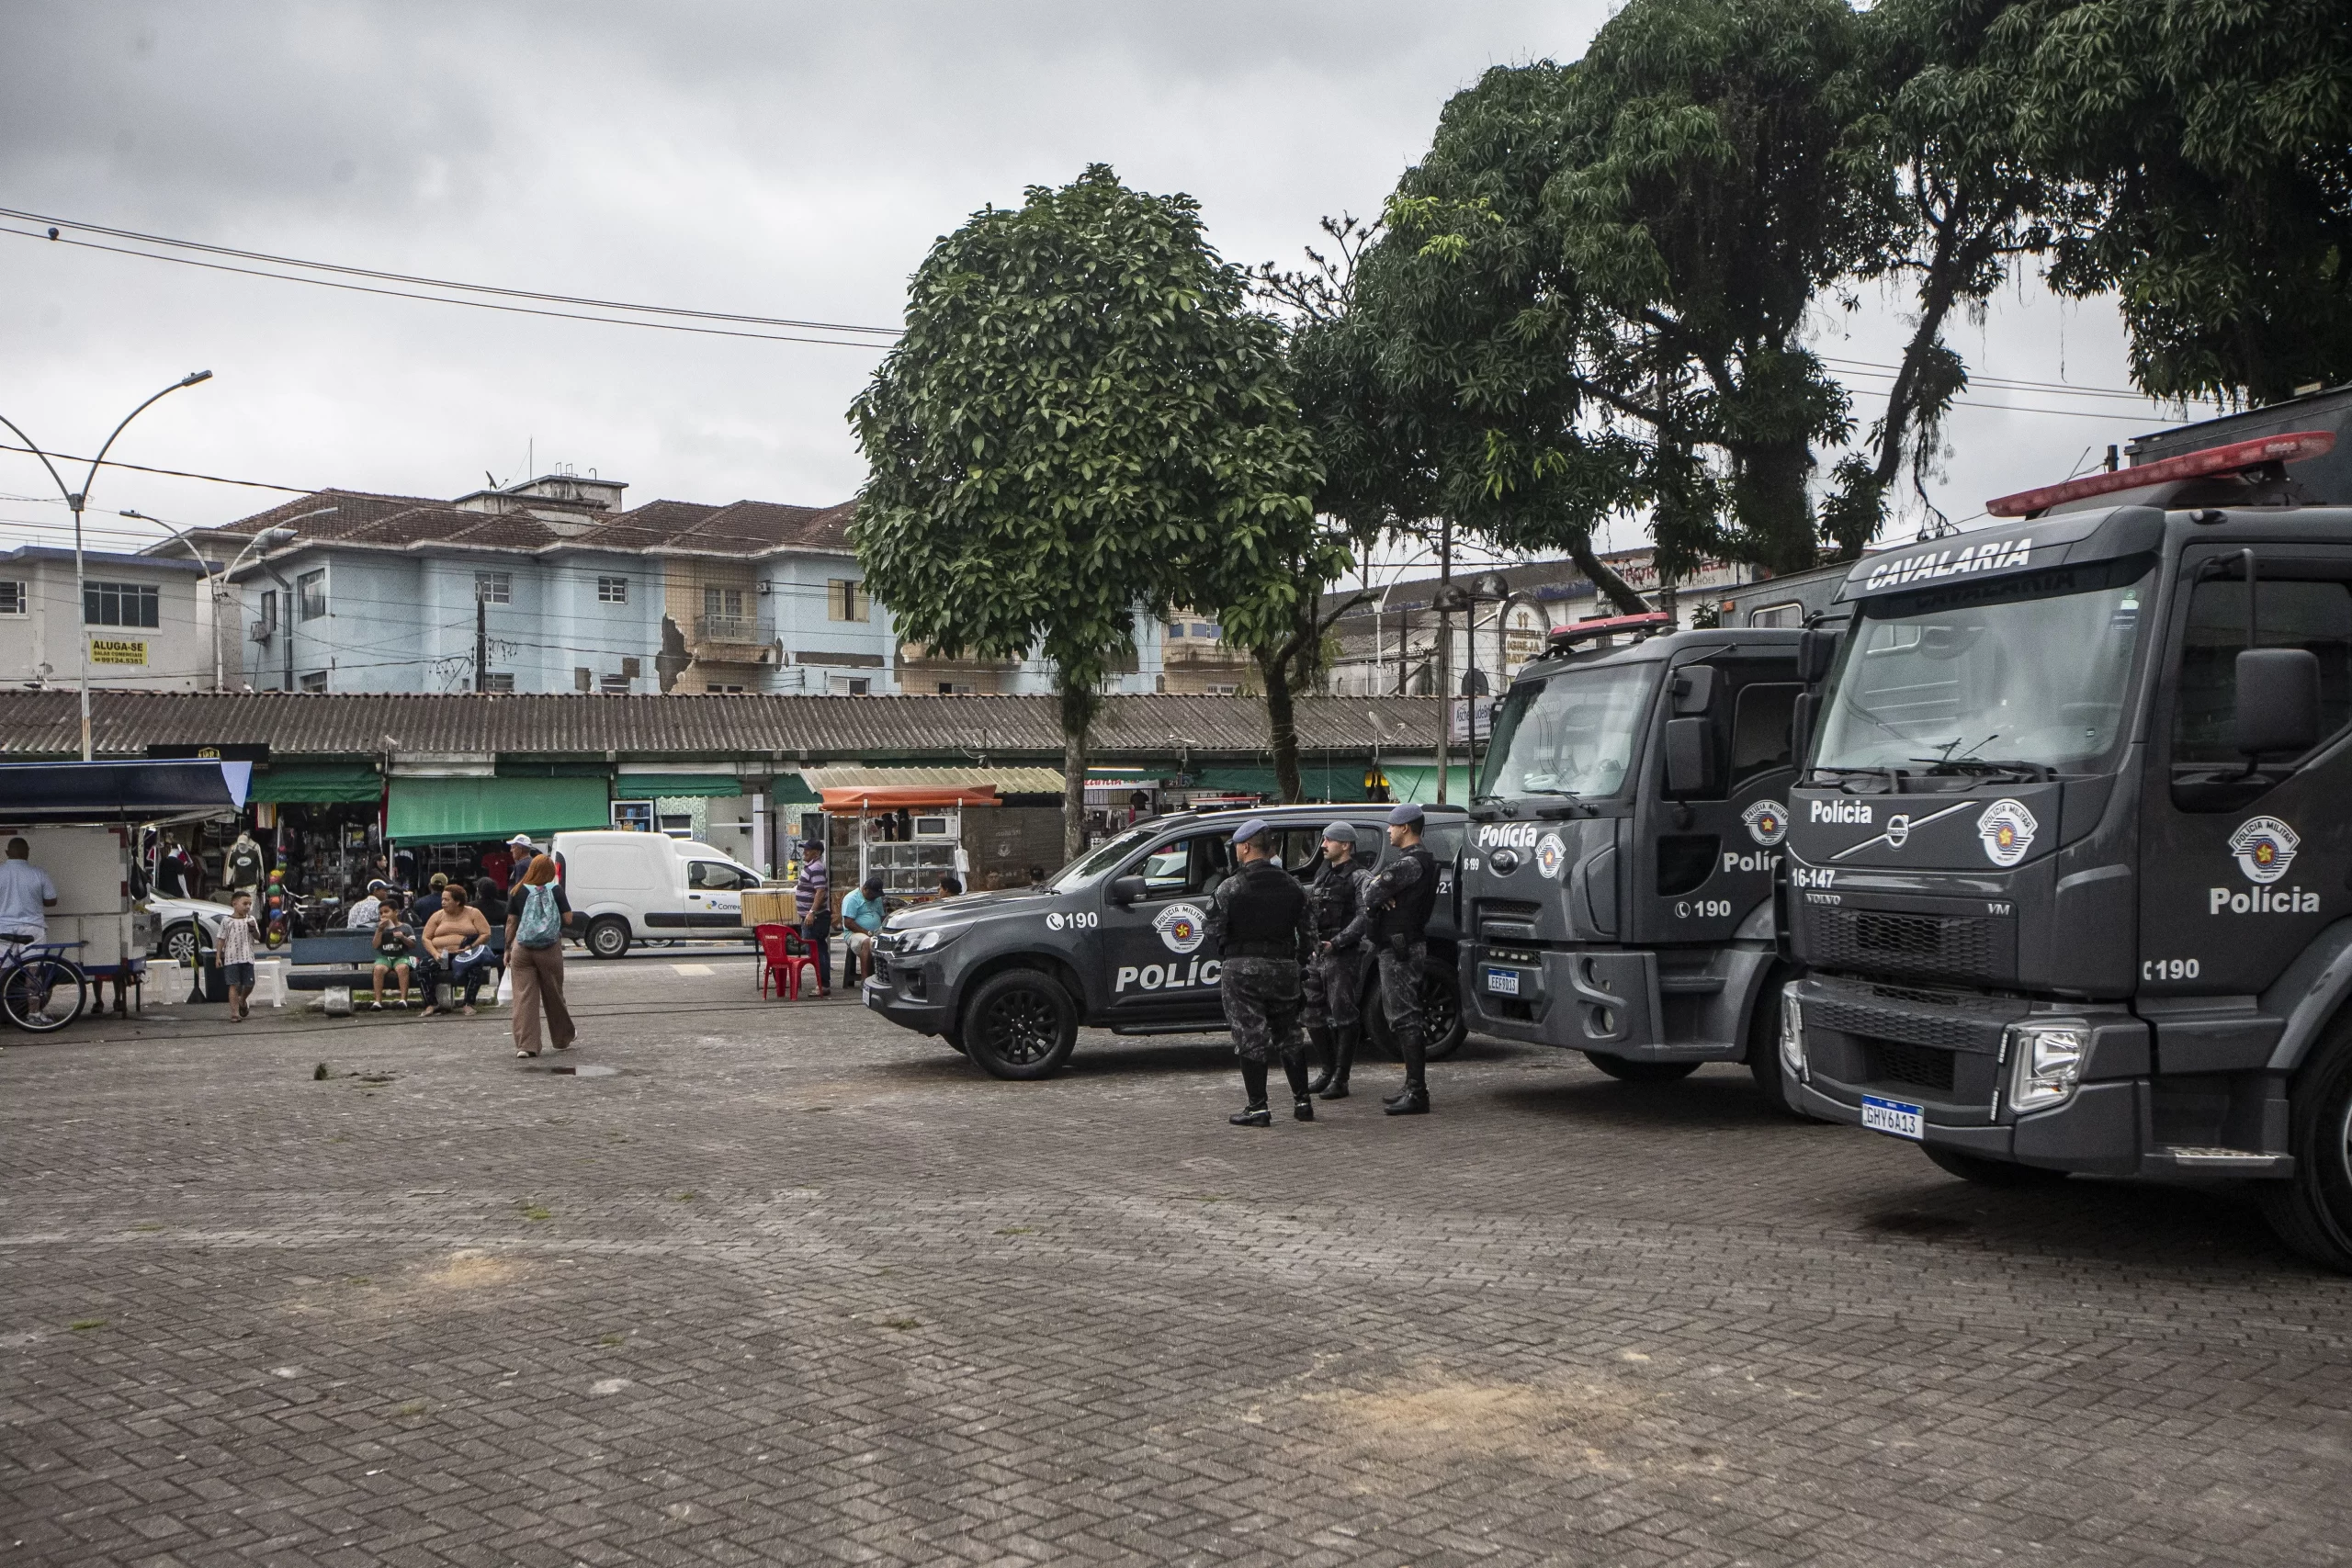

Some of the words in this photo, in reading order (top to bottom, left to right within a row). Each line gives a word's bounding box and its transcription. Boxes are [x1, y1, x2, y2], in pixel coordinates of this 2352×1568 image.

[1866, 538, 2031, 590] CAVALARIA
[94, 640, 143, 651] ALUGA-SE
[1507, 640, 1540, 651] IGREJA
[1811, 799, 1872, 824] Polícia
[2008, 805, 2031, 829] MILITAR
[2267, 821, 2294, 844] MILITAR
[1792, 868, 1835, 888] 16-147
[1694, 900, 1731, 917] 190
[1805, 893, 1840, 905] VOLVO
[1988, 903, 2010, 915] VM
[2210, 886, 2320, 915] Polícia
[1066, 912, 1098, 929] 190
[1115, 955, 1222, 992] POLÍC
[2155, 959, 2199, 979] 190
[1867, 1107, 1916, 1134] GHY6A13
